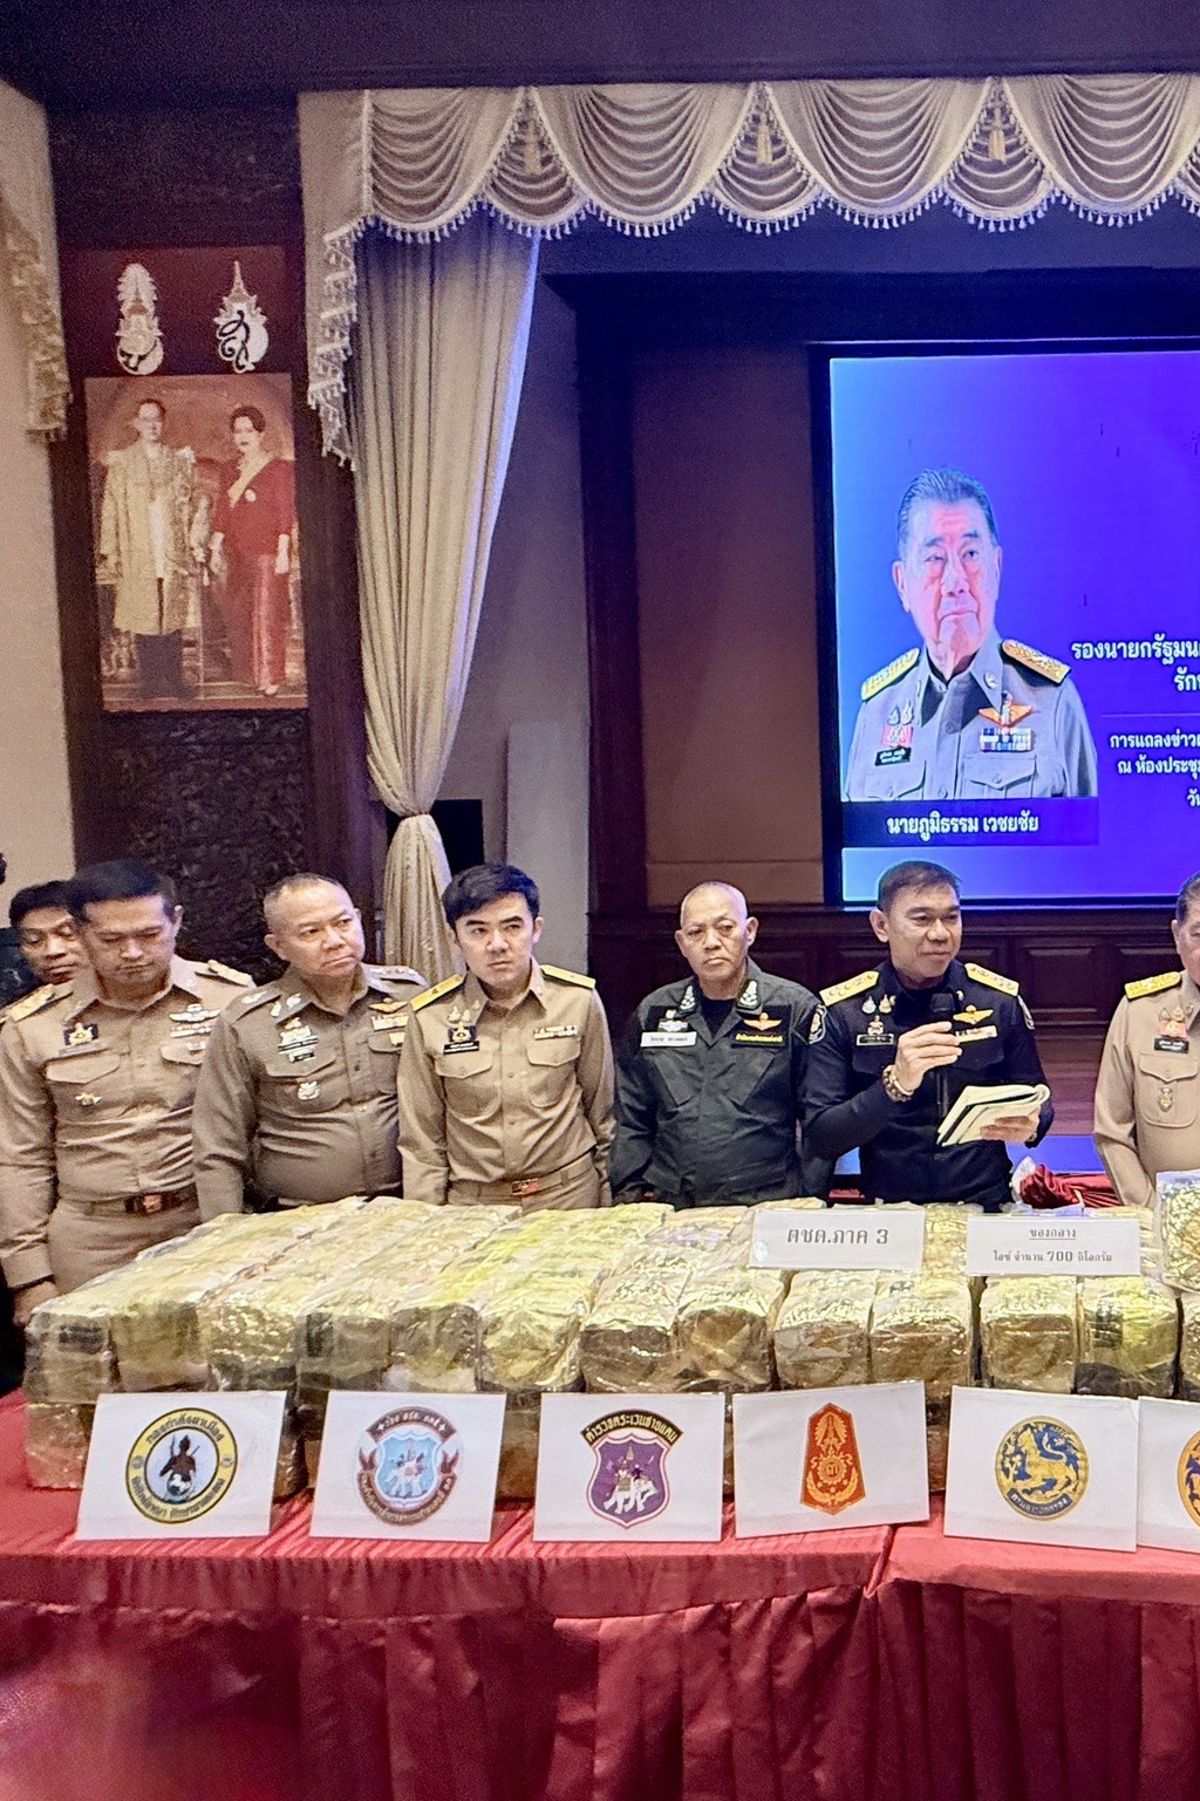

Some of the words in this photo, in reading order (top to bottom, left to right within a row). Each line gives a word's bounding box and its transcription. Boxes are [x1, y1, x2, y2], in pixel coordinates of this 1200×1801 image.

[1117, 760, 1132, 774] ณ
[886, 810, 979, 841] นายภูมิธรรม
[983, 810, 1039, 833] เวชยชัย
[787, 1228, 868, 1243] ตชด.ภาค
[876, 1228, 889, 1244] 3
[1029, 1228, 1077, 1239] ของกลาง
[1014, 1250, 1044, 1262] จำนวน
[1046, 1250, 1073, 1262] 700
[1078, 1250, 1113, 1262] กิโลกรัม
